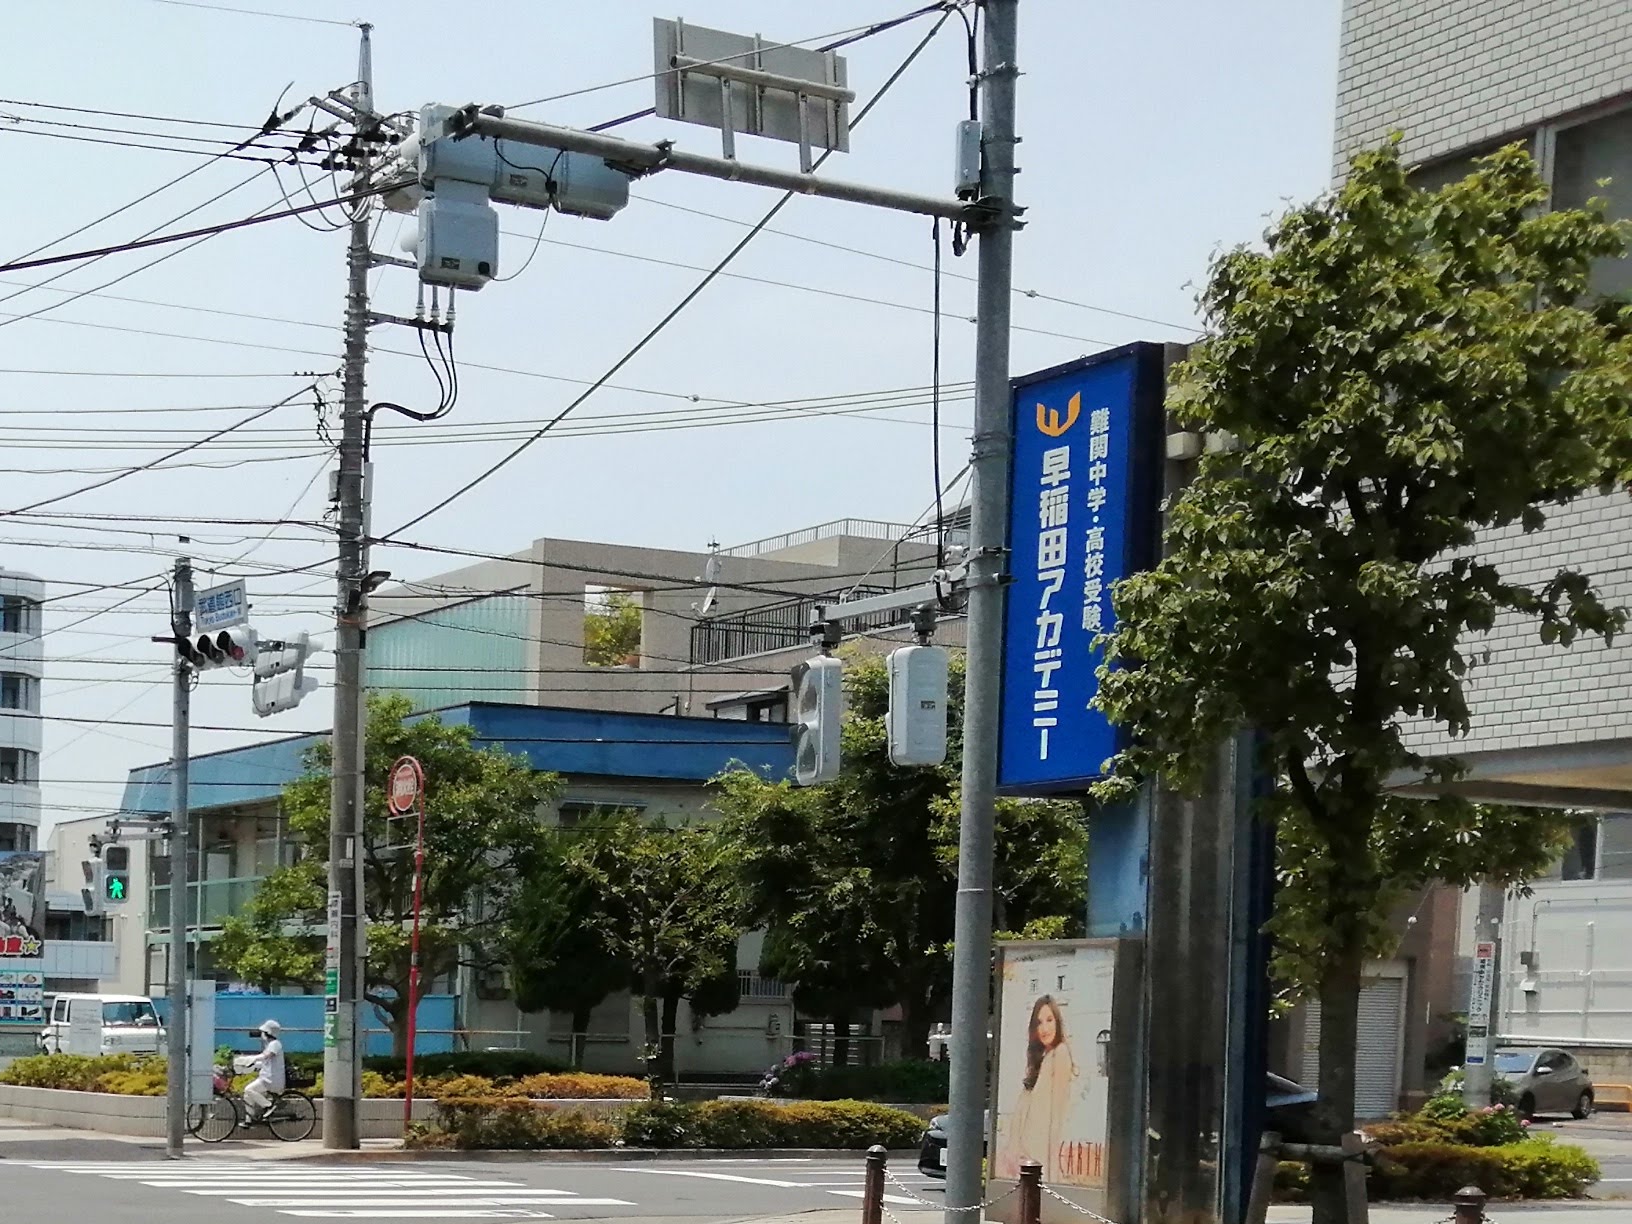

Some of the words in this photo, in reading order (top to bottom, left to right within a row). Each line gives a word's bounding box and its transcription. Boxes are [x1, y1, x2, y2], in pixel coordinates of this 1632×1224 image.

[1033, 446, 1070, 760] 早稲田アカデミー
[1082, 407, 1110, 631] 難関中学・高校受験
[1059, 1141, 1102, 1177] EARTH
